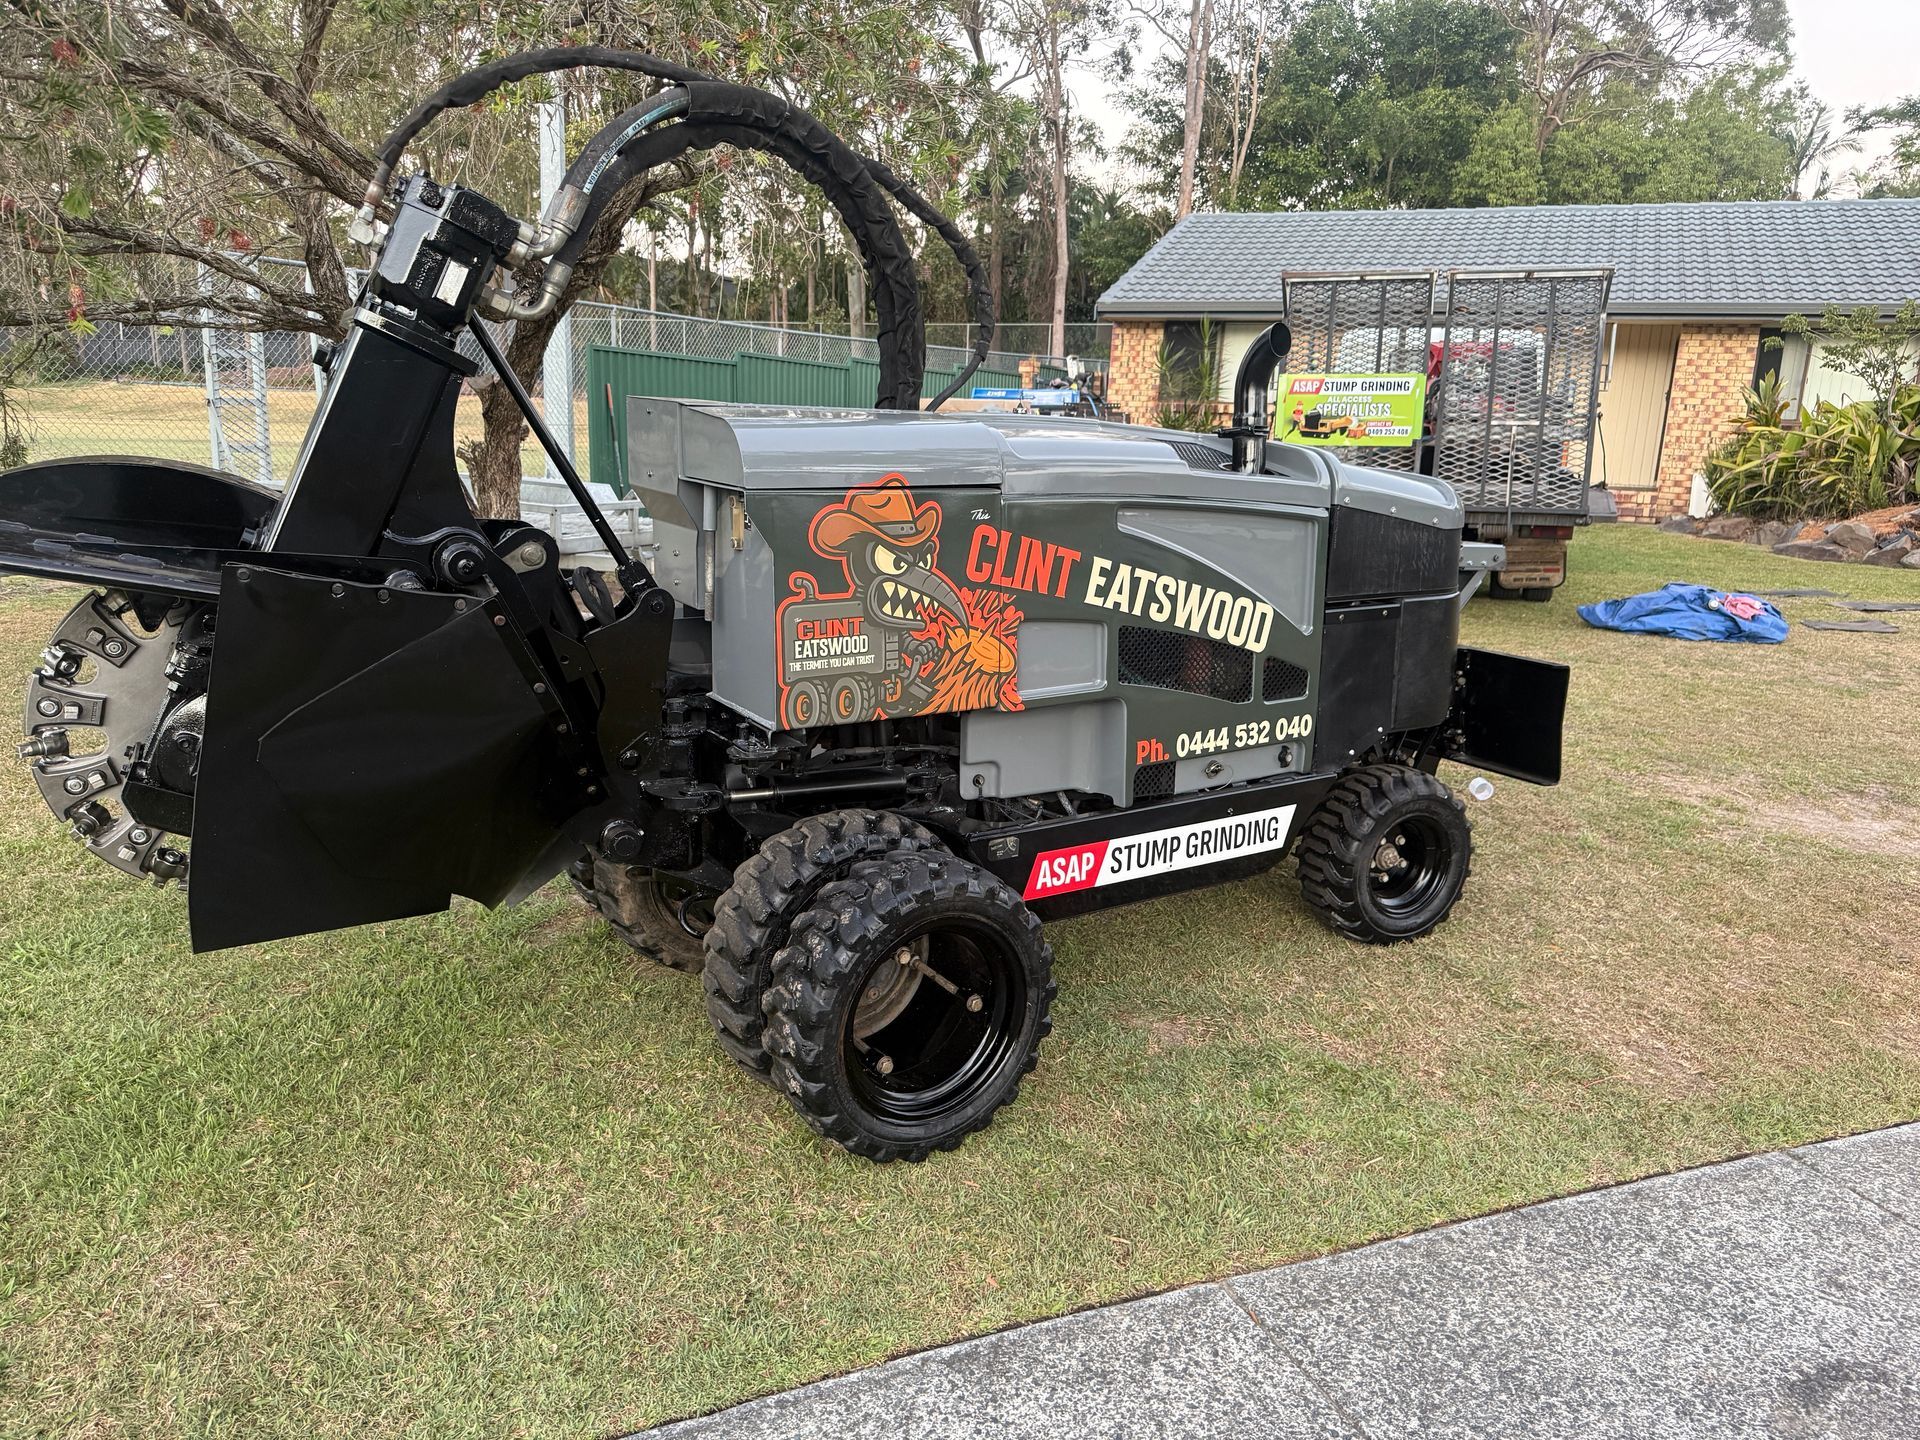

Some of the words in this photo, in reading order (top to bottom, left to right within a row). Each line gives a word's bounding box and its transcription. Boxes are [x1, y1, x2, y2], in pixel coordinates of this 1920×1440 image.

[1292, 380, 1320, 392] ASAP
[1323, 381, 1358, 392] STUMP
[1361, 380, 1410, 392] GRINDING
[1342, 395, 1373, 403] ACCESS
[1316, 402, 1391, 417] SPECIALISTS
[970, 508, 991, 521] This
[966, 524, 1081, 599] CLINT
[1084, 556, 1275, 653] EATSWOOD
[797, 617, 865, 640] CLINT
[794, 635, 869, 659] EATSWOOD
[789, 661, 802, 672] THE
[802, 658, 829, 671] TERMITE
[829, 657, 842, 668] YOU
[842, 656, 855, 667] CAN
[855, 654, 875, 665] TRUST
[1137, 738, 1170, 765] Ph.
[1176, 726, 1230, 758] 0444
[1234, 720, 1271, 748] 532
[1275, 714, 1313, 740] 040
[1035, 852, 1095, 890] ASAP
[1110, 836, 1181, 874] STUMP
[1186, 816, 1279, 859] GRINDING
